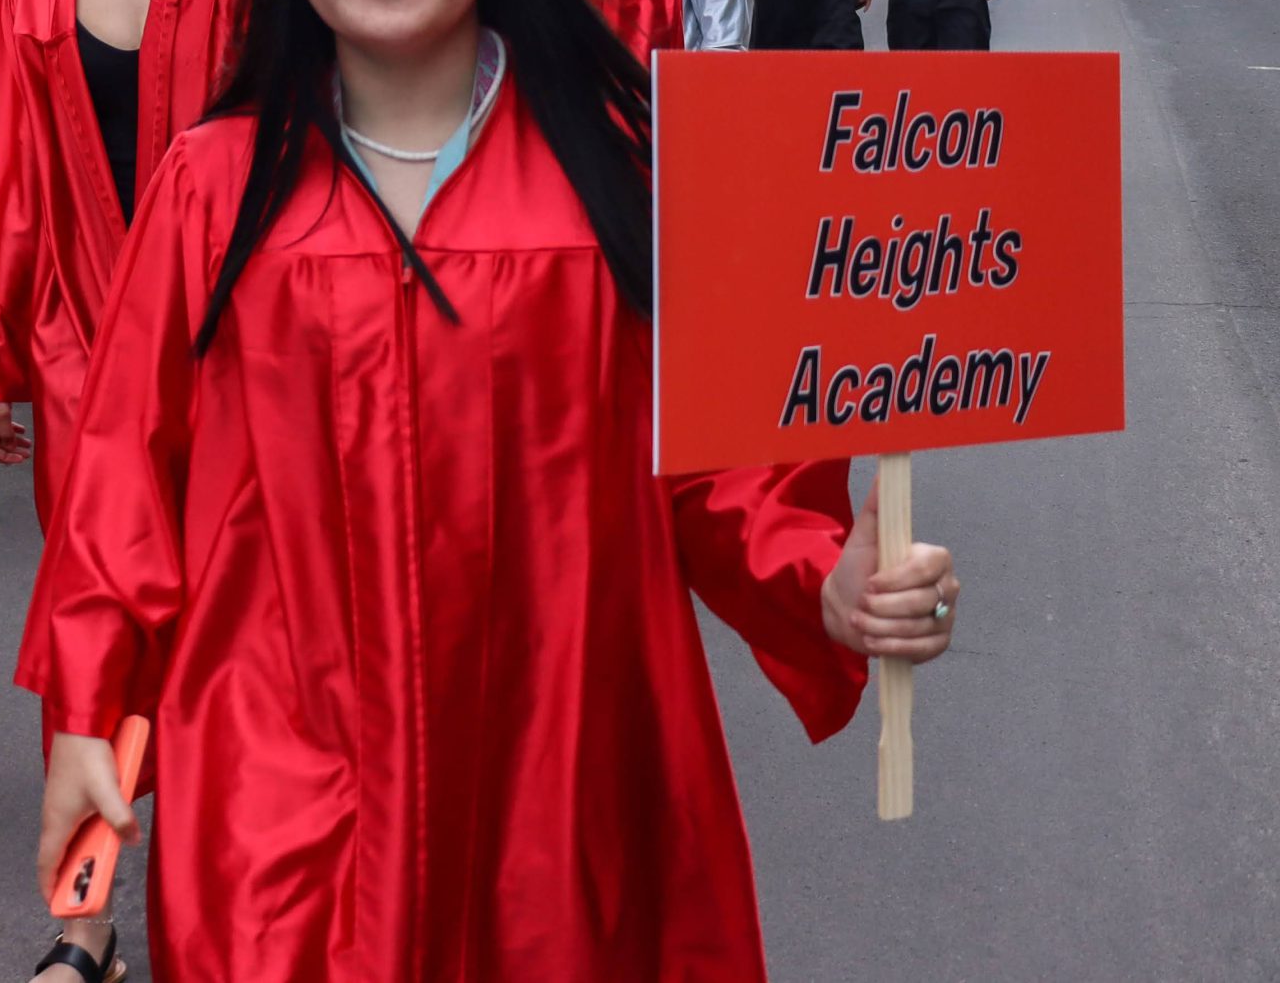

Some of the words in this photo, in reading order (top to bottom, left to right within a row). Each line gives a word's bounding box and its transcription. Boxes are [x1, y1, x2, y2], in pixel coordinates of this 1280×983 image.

[819, 89, 1004, 174] Falcon
[805, 208, 1022, 311] Heights
[778, 333, 1052, 429] Academy
